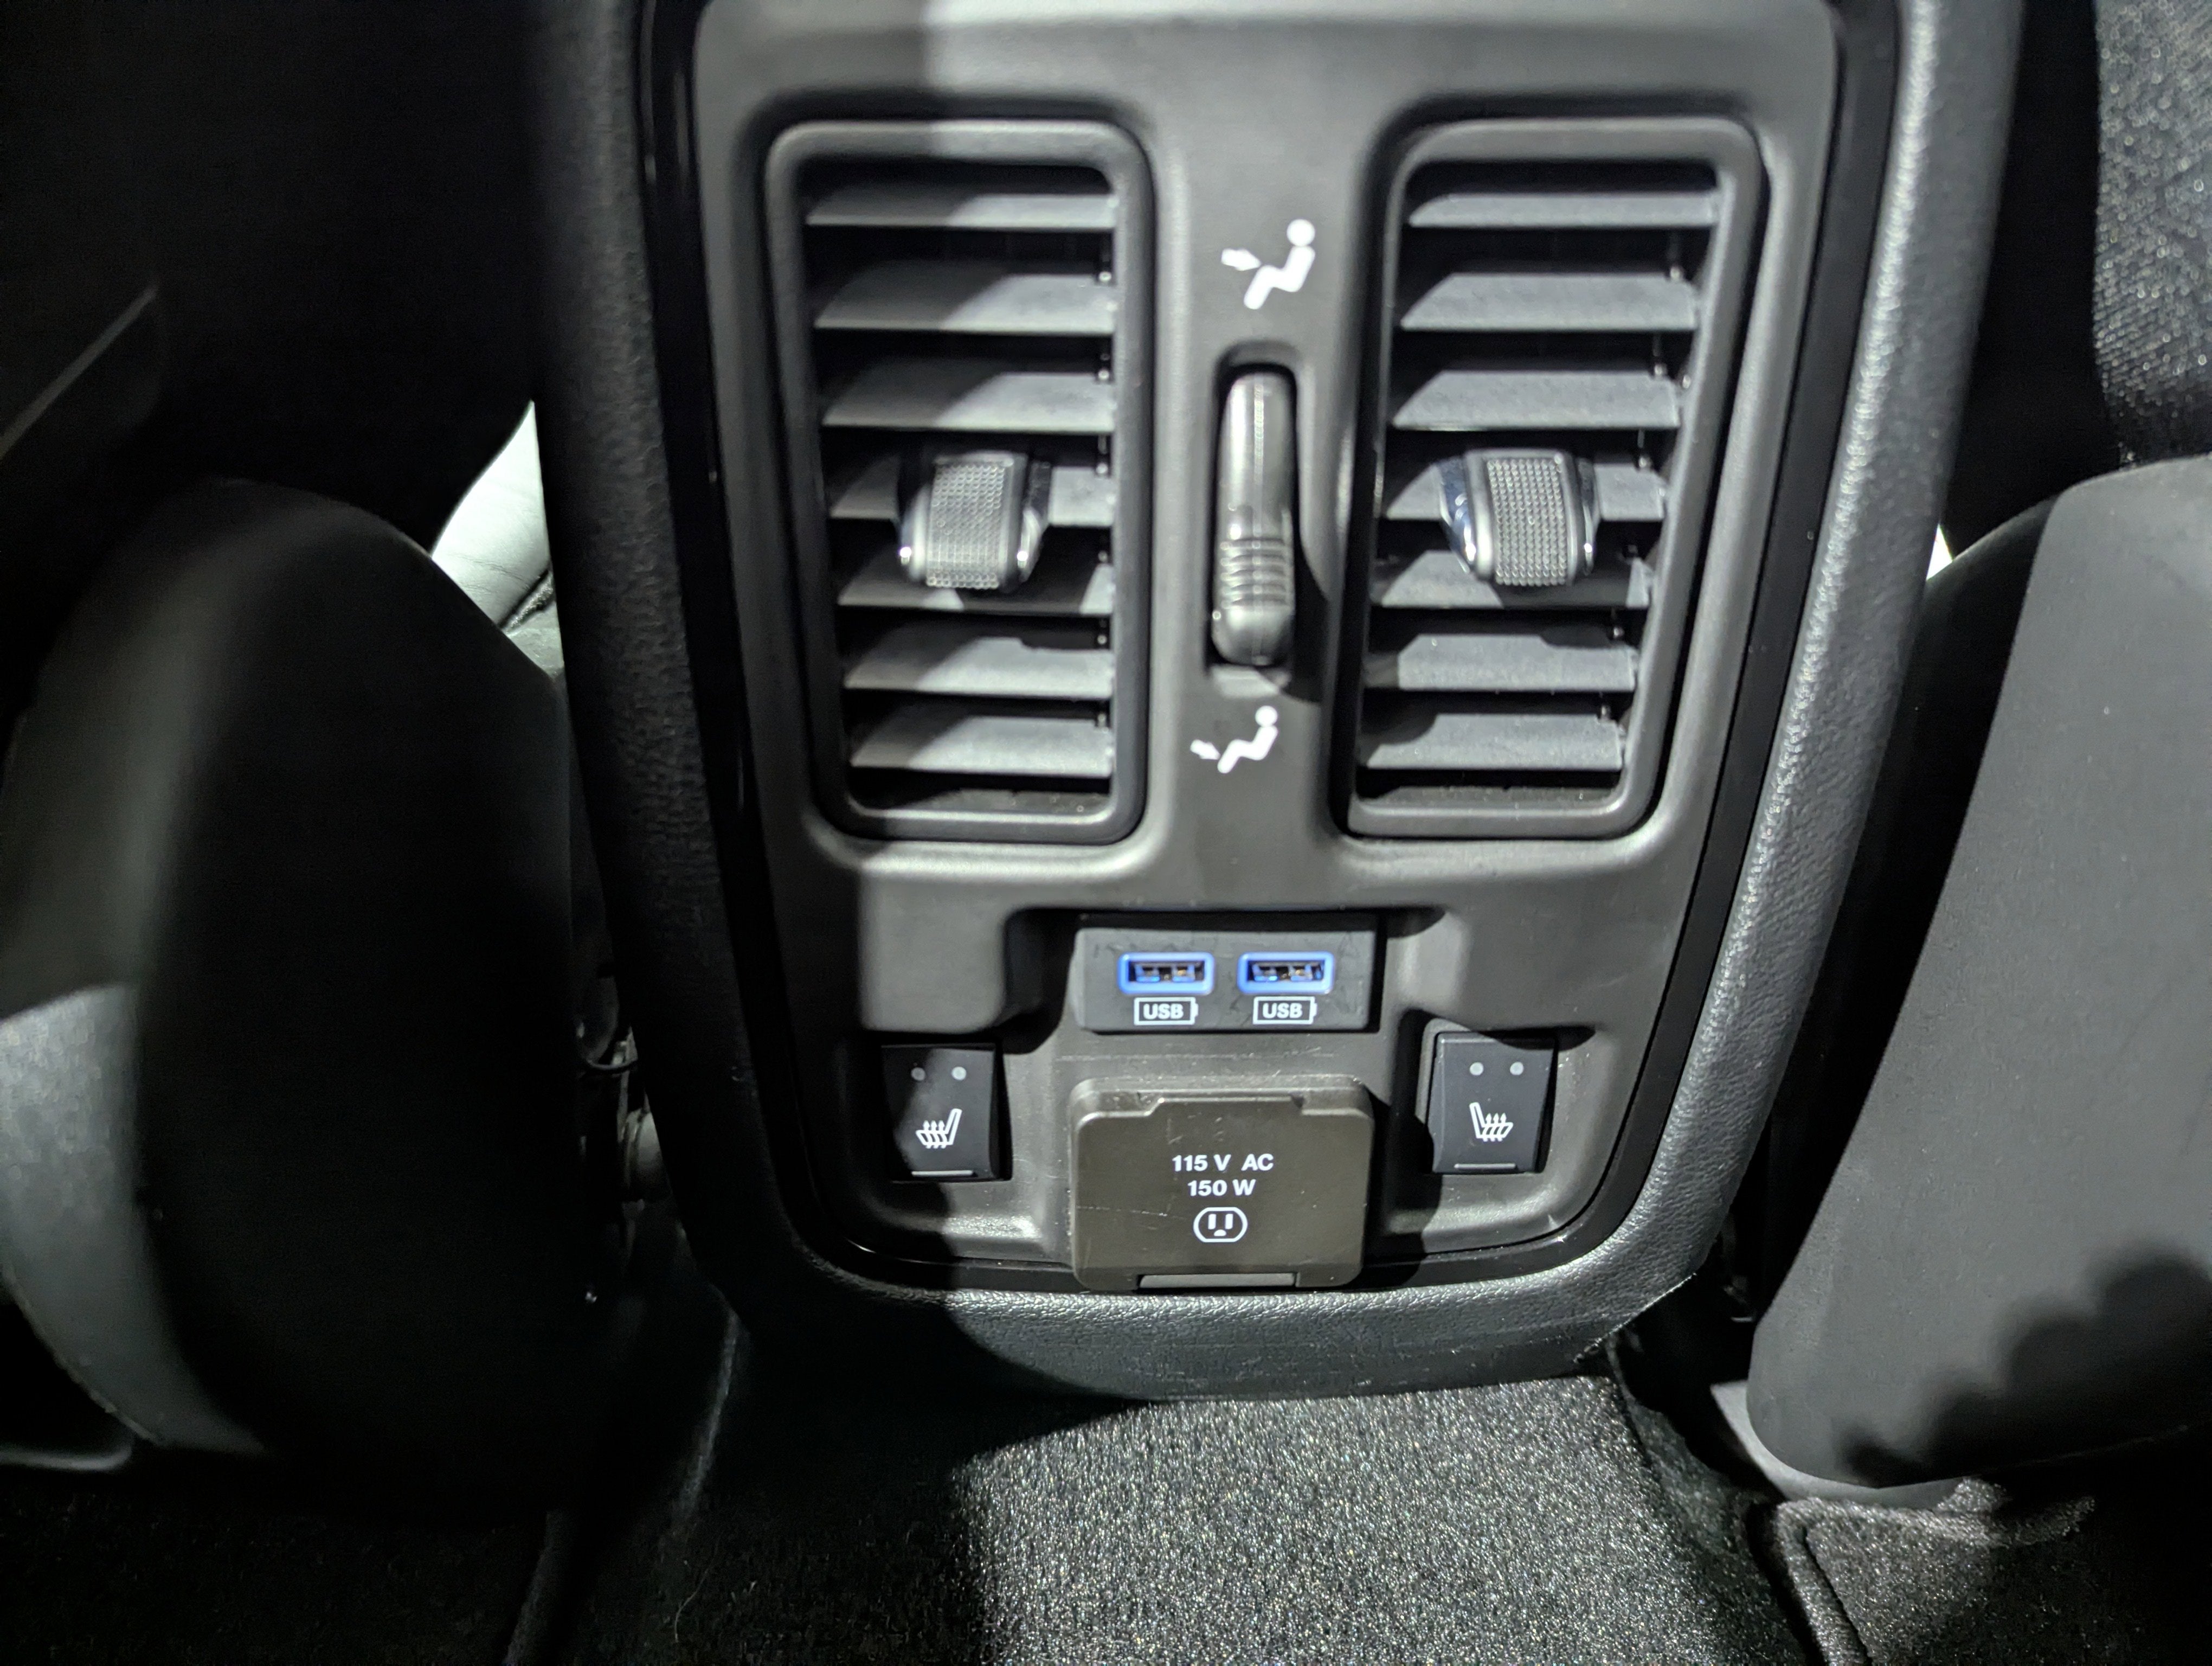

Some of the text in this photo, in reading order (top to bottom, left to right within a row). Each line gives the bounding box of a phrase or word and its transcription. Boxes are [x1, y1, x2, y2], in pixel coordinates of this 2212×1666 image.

[1143, 1003, 1185, 1020] USB
[1262, 1002, 1303, 1020] USB
[1172, 1153, 1275, 1172] 115 V AC
[1187, 1178, 1257, 1197] 150 W
